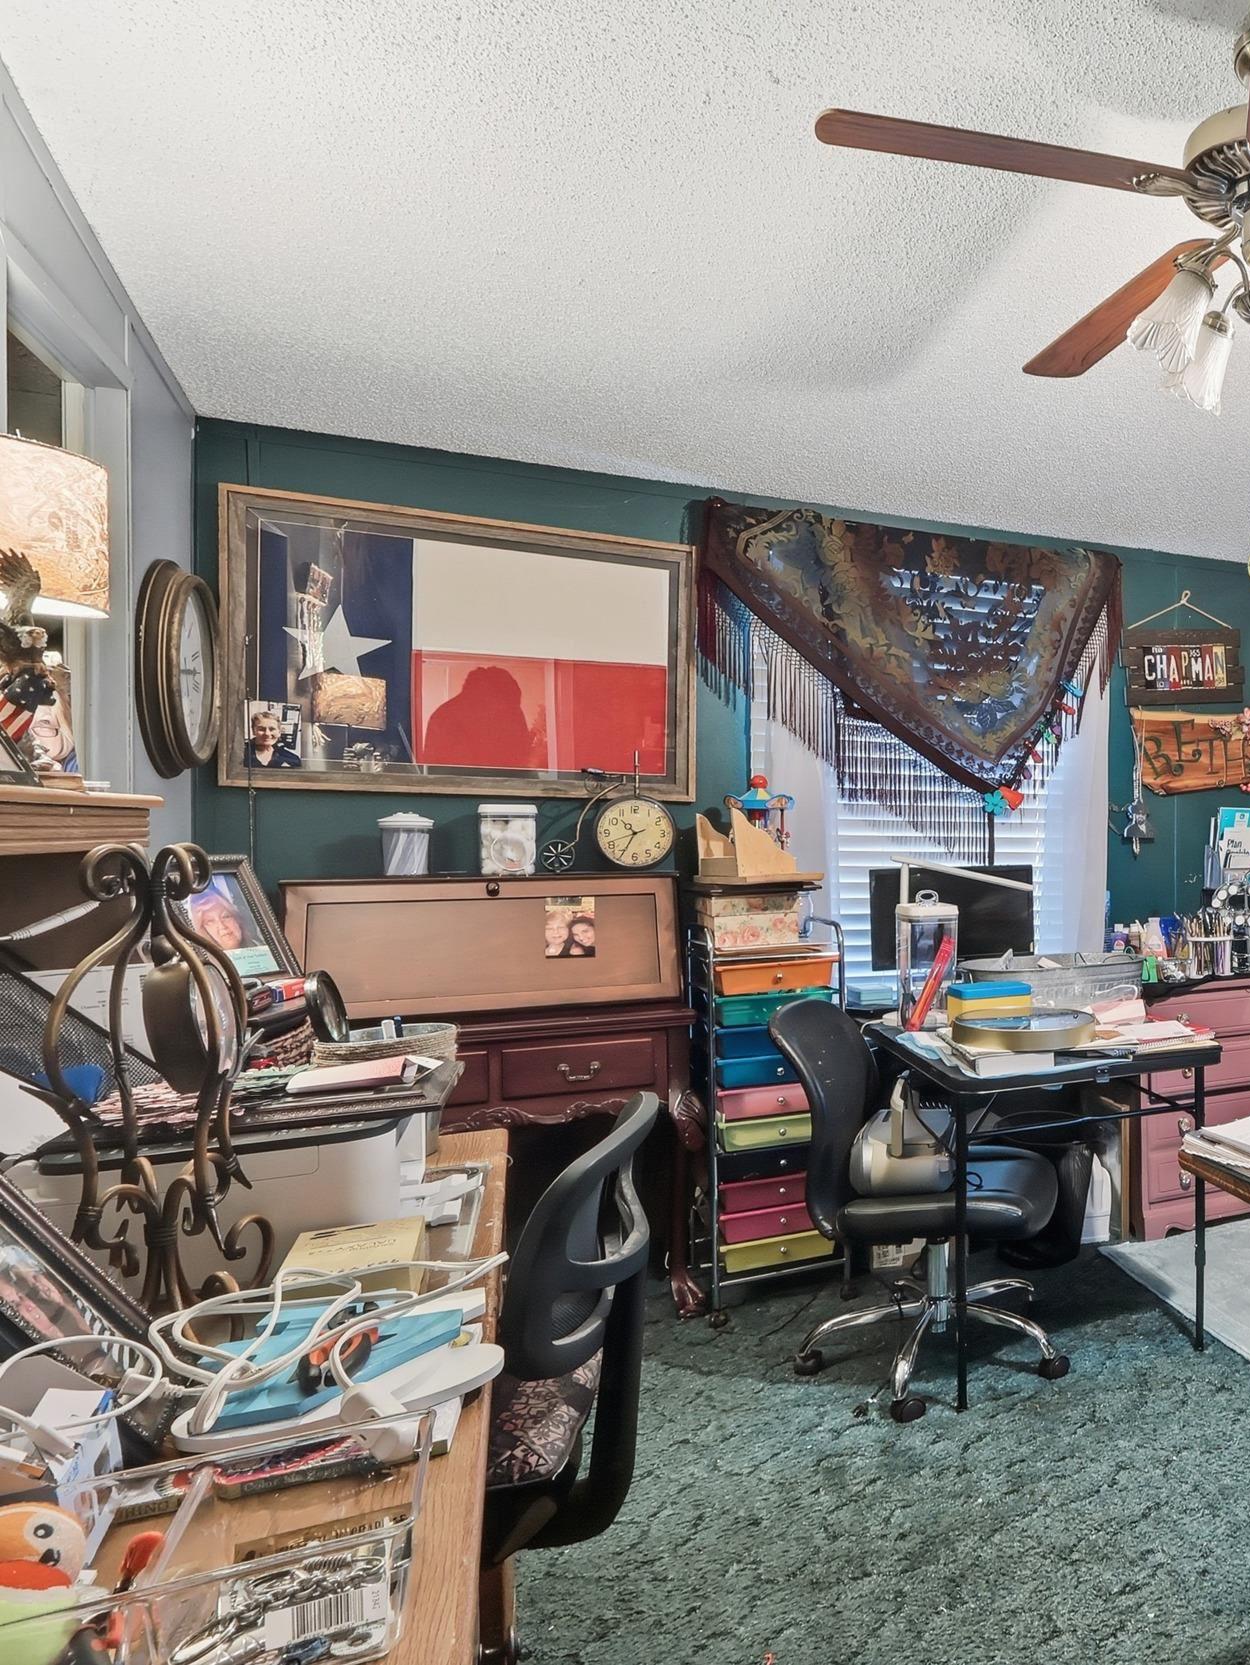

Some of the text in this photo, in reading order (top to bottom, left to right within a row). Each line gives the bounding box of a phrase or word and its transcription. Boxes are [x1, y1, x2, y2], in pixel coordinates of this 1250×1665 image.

[1144, 651, 1225, 683] CHAPMAN
[619, 809, 625, 817] 11
[630, 805, 640, 814] 12
[647, 809, 651, 817] 1
[608, 817, 619, 826] 10
[654, 817, 662, 826] 2
[603, 829, 611, 837] 9
[660, 829, 666, 838] 3
[608, 841, 616, 850] 8
[654, 841, 661, 849] 4
[1227, 839, 1243, 849] Plan
[631, 853, 638, 861] 6
[645, 849, 651, 858] 5
